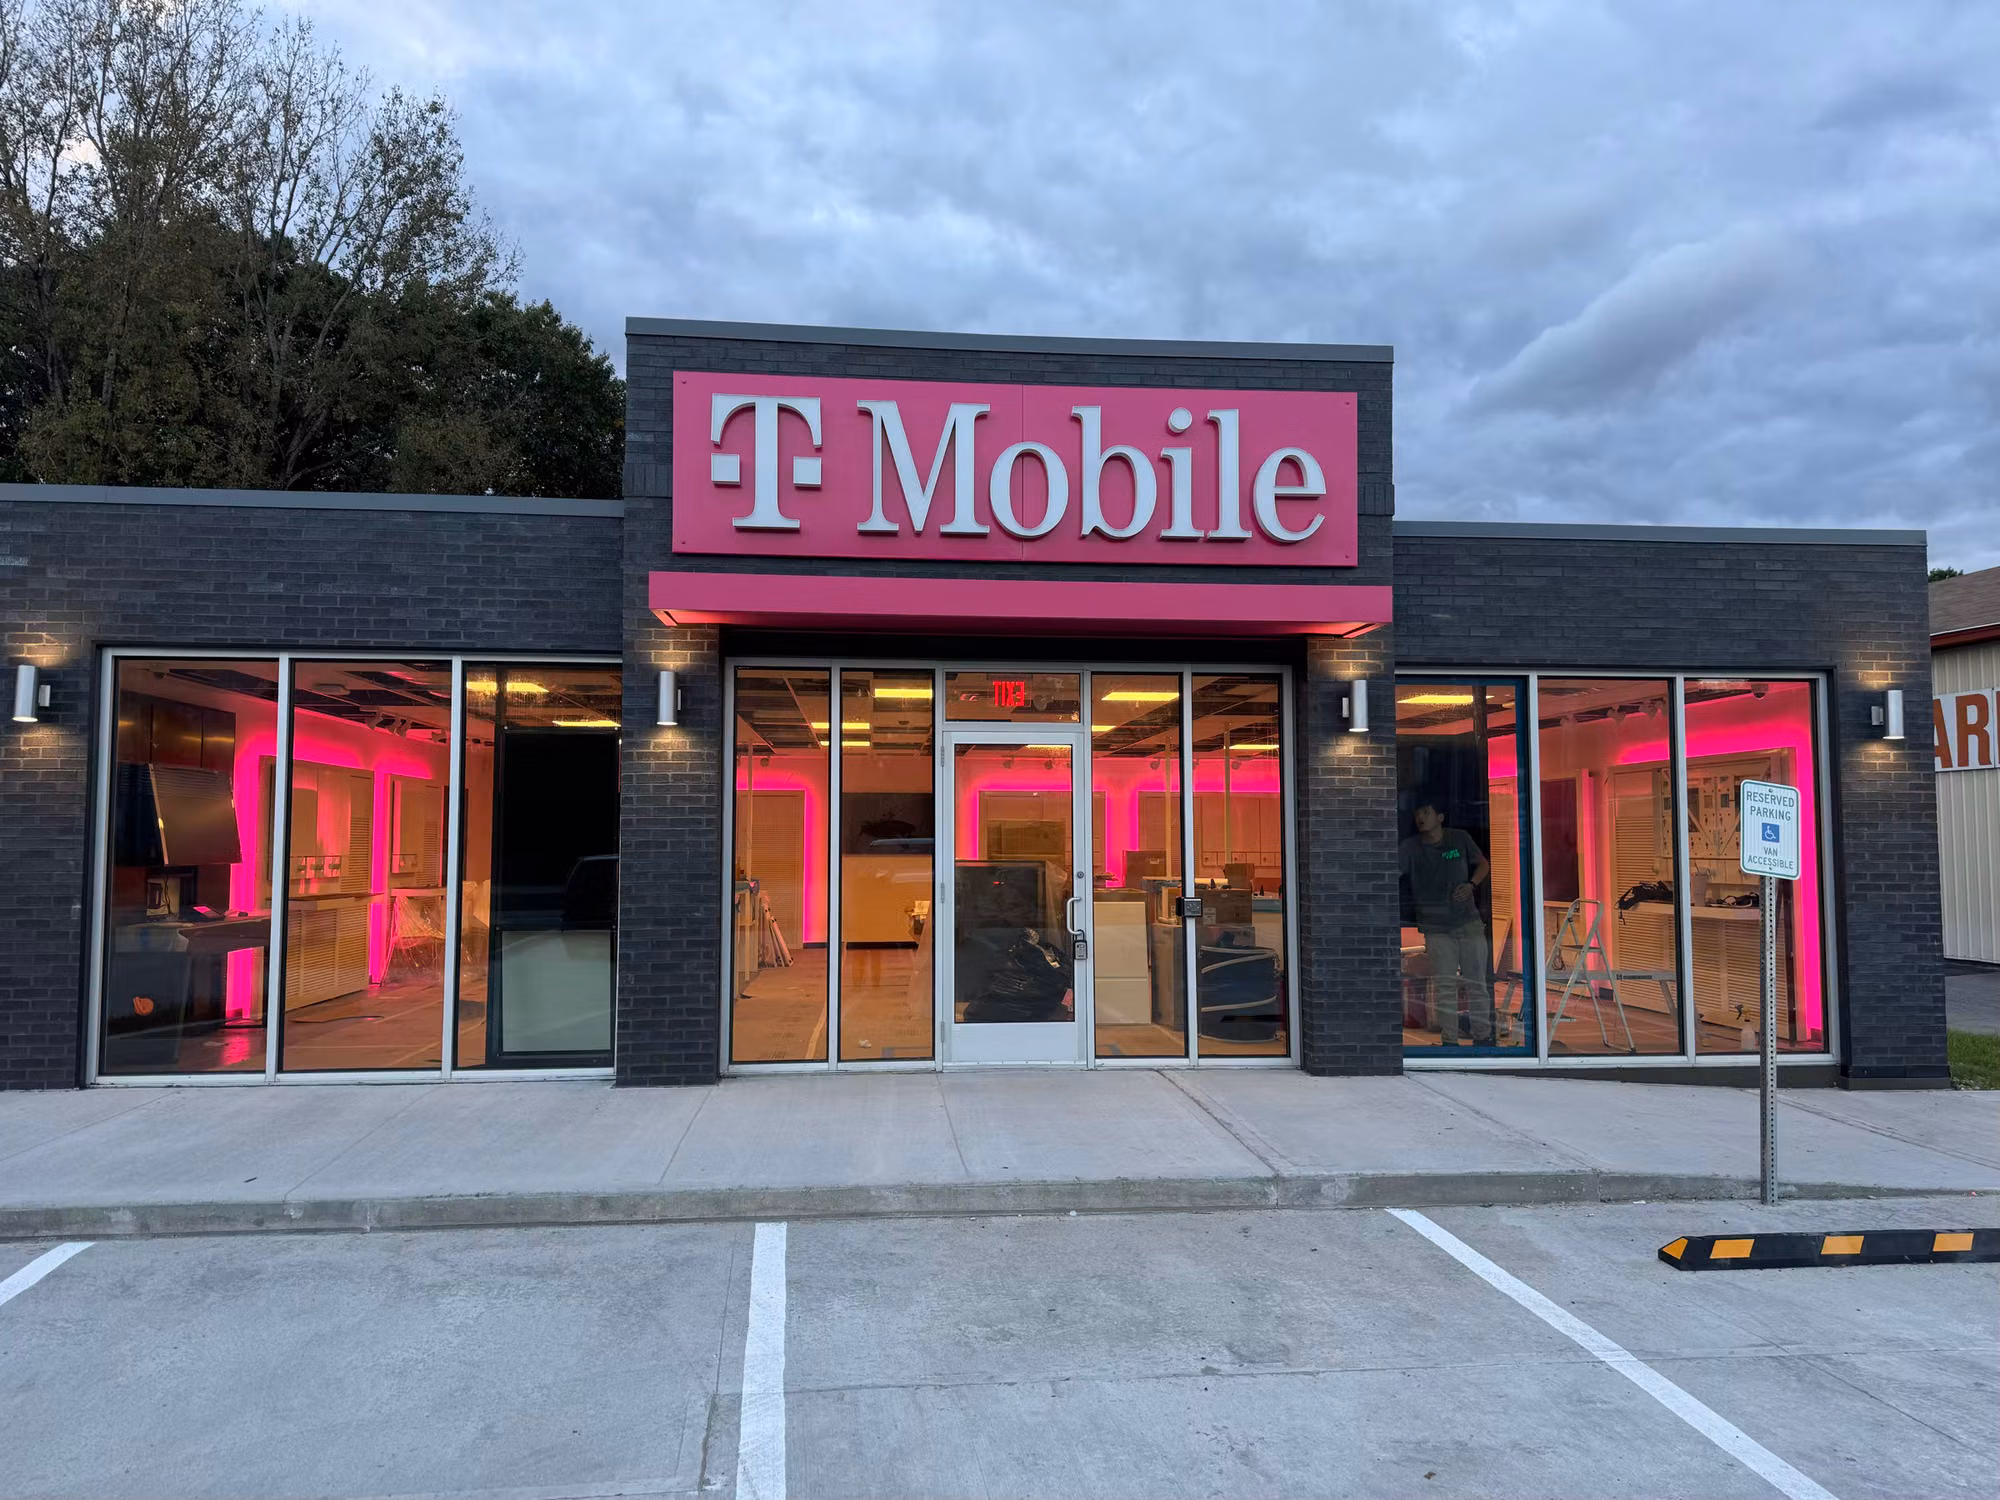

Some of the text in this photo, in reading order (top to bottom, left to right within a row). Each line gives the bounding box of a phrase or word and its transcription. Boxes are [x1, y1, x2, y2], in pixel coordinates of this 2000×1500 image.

[857, 399, 1327, 544] Mobile
[1746, 791, 1795, 807] RESERVED
[1750, 806, 1791, 821] PARKING
[1763, 847, 1778, 856] VAN
[1748, 856, 1793, 869] ACCESSIBLE
